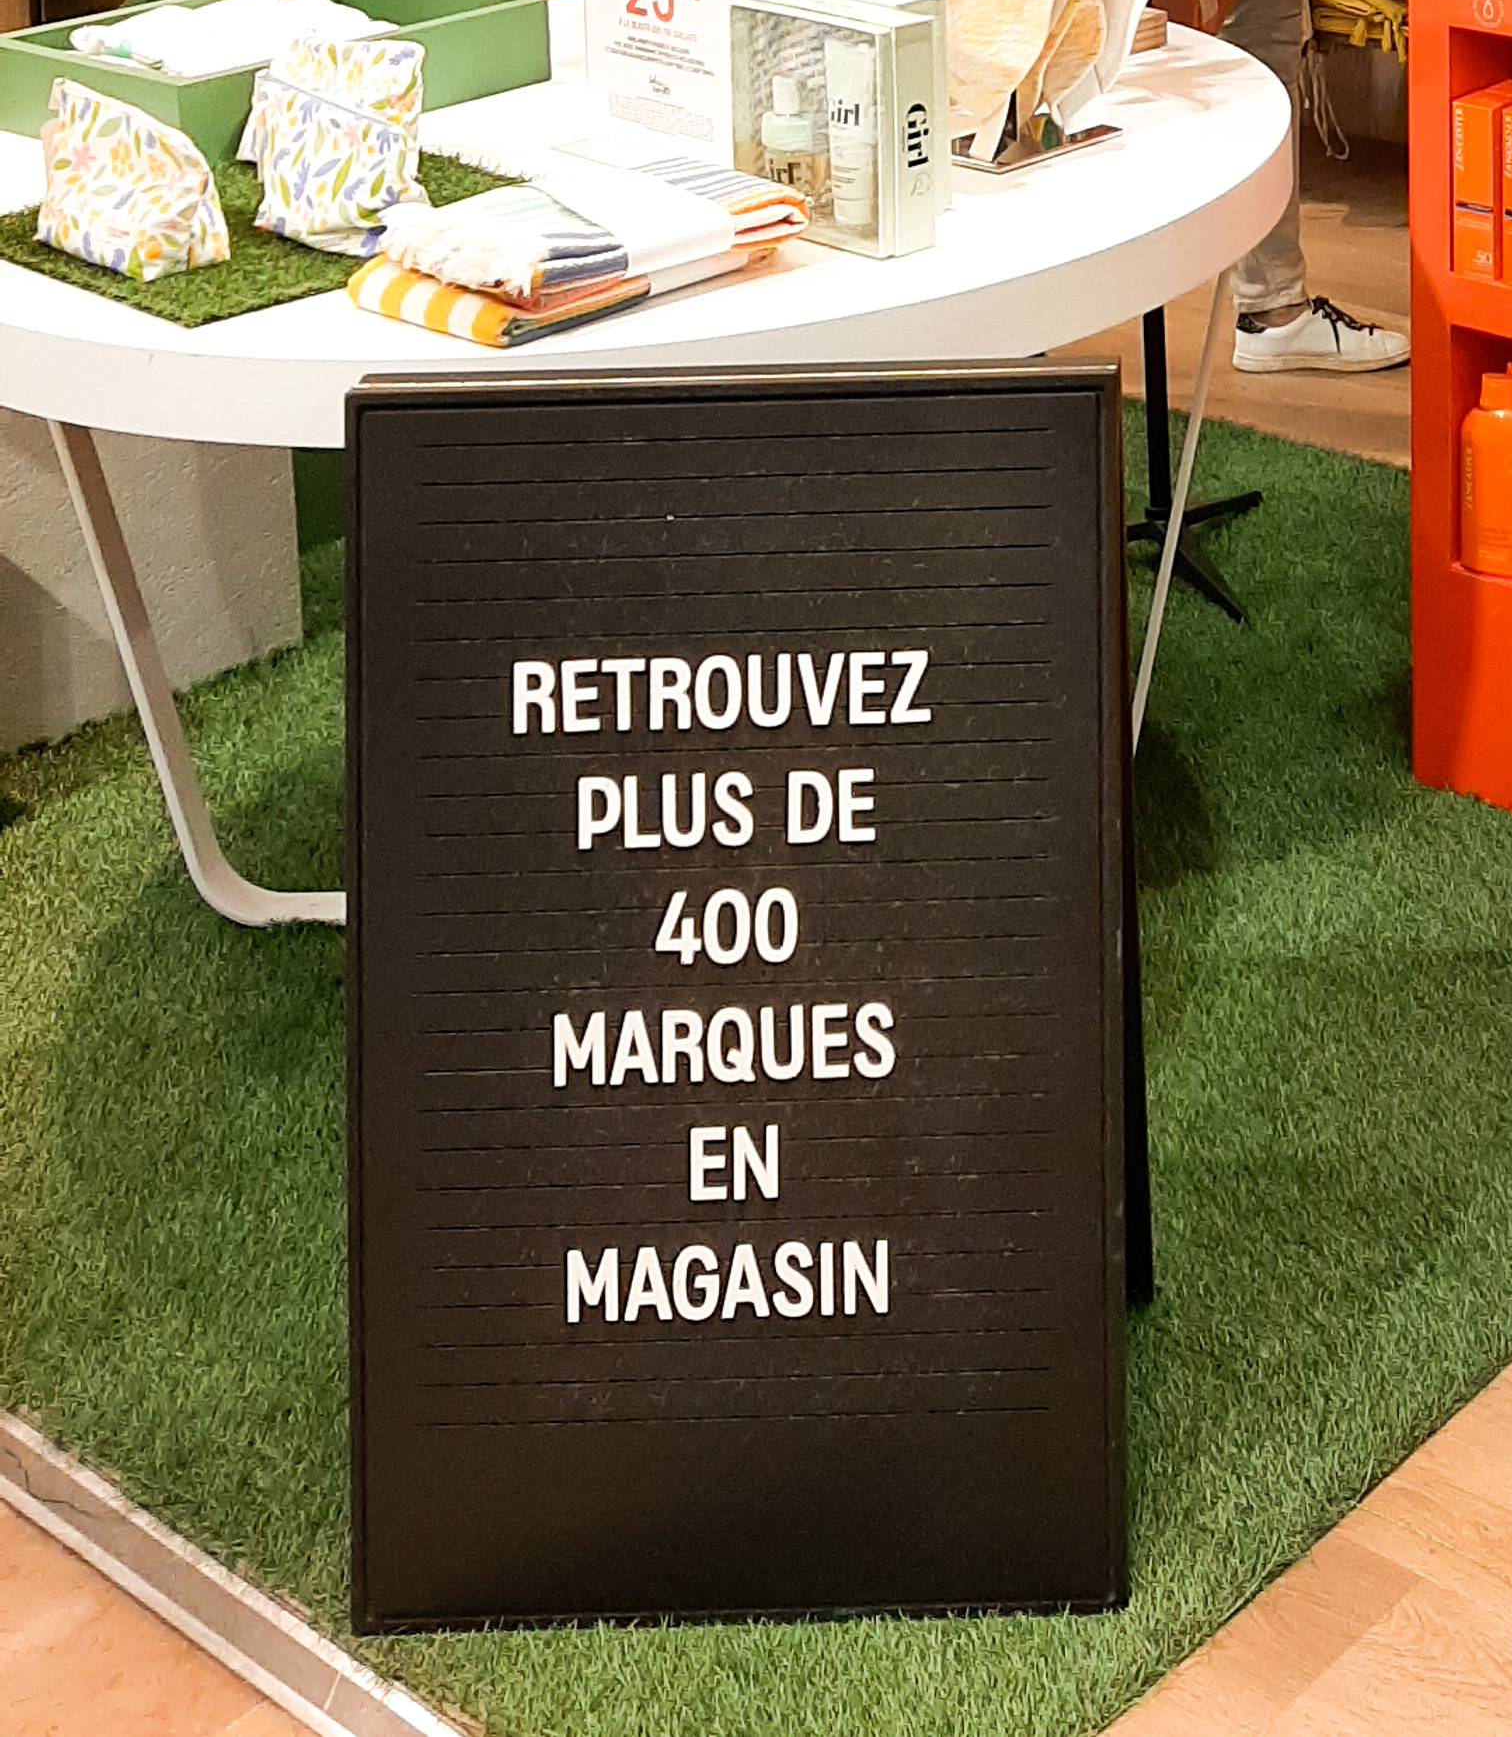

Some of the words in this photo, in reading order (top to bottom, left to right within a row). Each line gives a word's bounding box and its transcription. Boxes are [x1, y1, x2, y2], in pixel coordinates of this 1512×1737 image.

[906, 103, 930, 168] Girl
[512, 650, 932, 735] RETROUVEZ
[577, 770, 755, 851] PLUS
[786, 769, 876, 845] DE
[655, 888, 799, 965] 400
[553, 1002, 896, 1088] MARQUES
[690, 1124, 780, 1202] EN
[566, 1239, 891, 1324] MAGASIN
